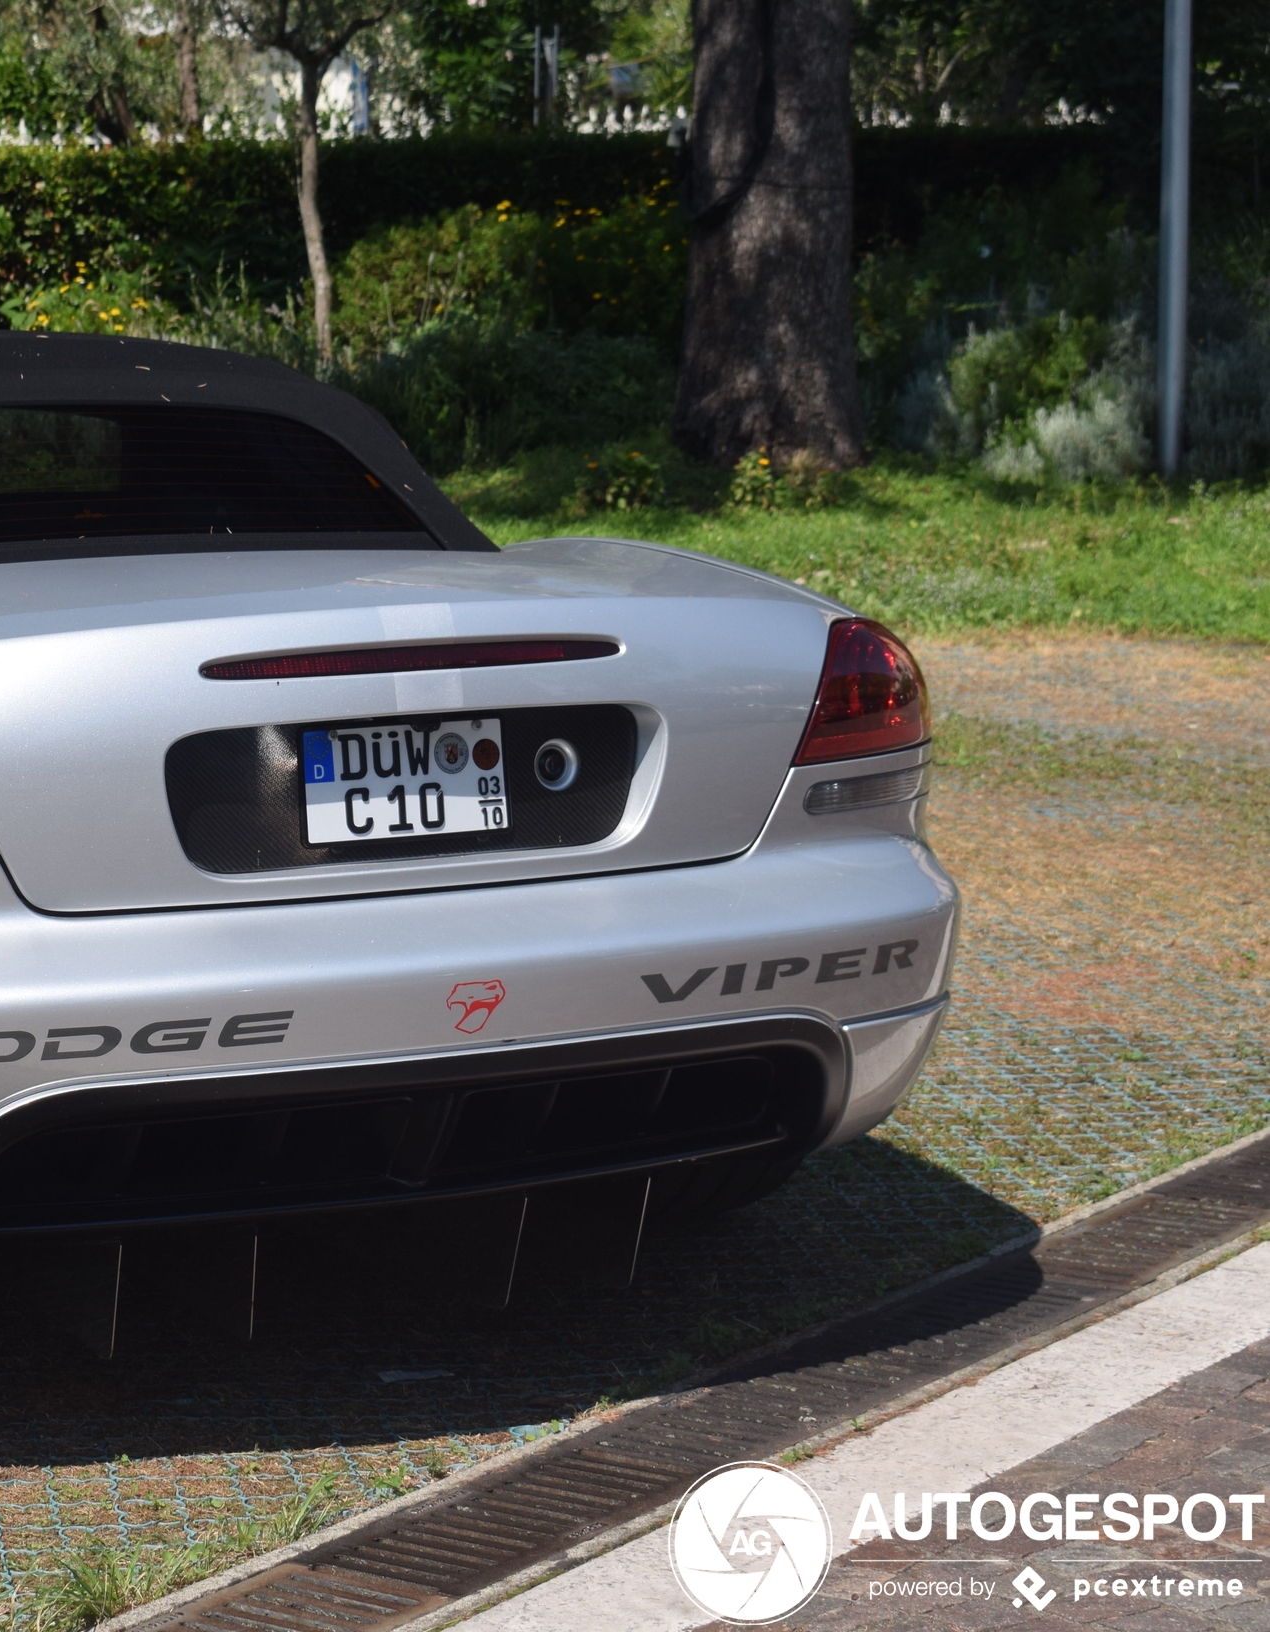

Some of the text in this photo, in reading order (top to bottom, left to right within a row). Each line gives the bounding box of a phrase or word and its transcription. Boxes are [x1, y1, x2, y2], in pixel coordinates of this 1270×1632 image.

[314, 764, 325, 780] D
[338, 730, 433, 781] DÜW
[478, 776, 501, 796] 03
[344, 782, 446, 835] C 10
[481, 806, 504, 827] 10
[640, 938, 920, 1004] VIPER
